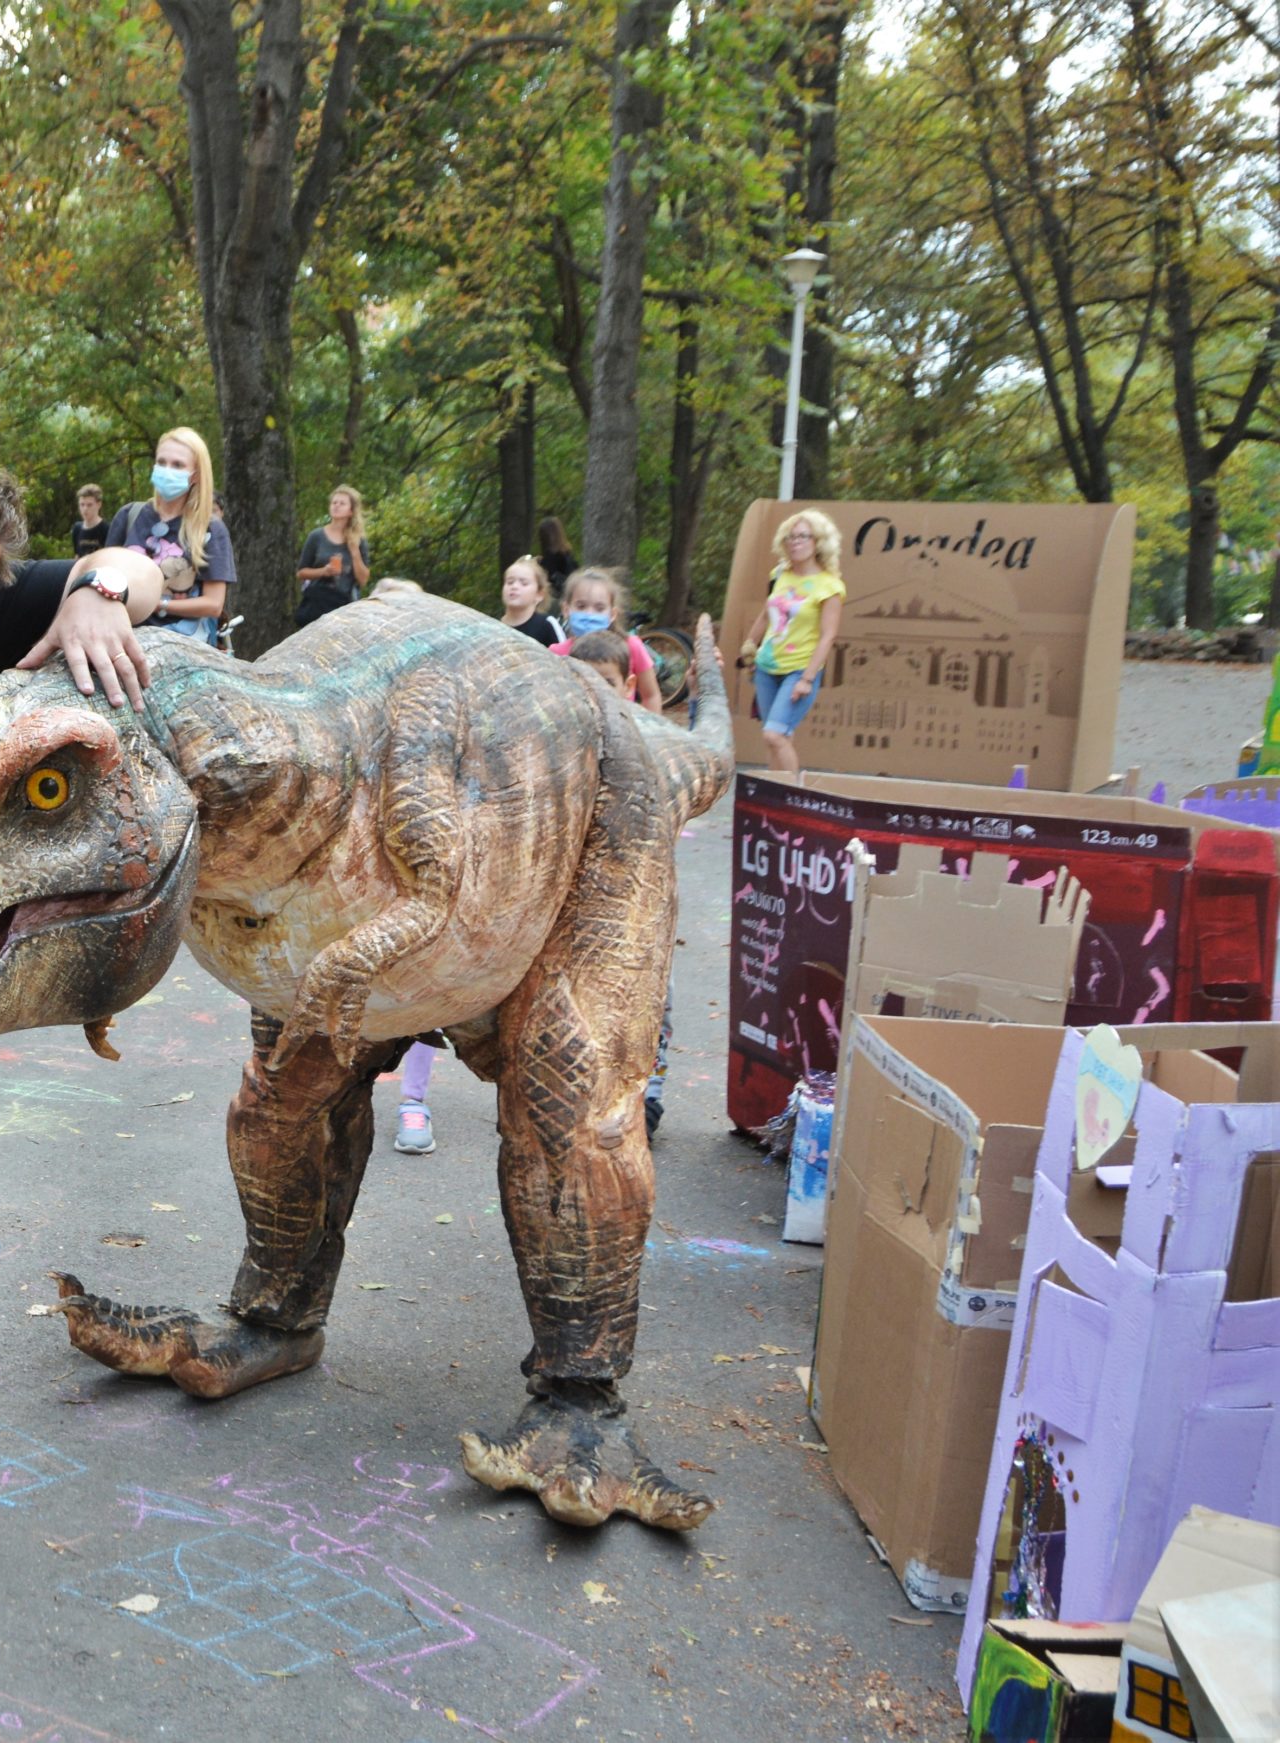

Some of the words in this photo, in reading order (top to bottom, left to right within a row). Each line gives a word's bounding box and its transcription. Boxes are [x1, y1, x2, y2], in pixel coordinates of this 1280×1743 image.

[854, 517, 1036, 569] Oradea
[741, 834, 769, 877] LG
[778, 845, 836, 895] UHD
